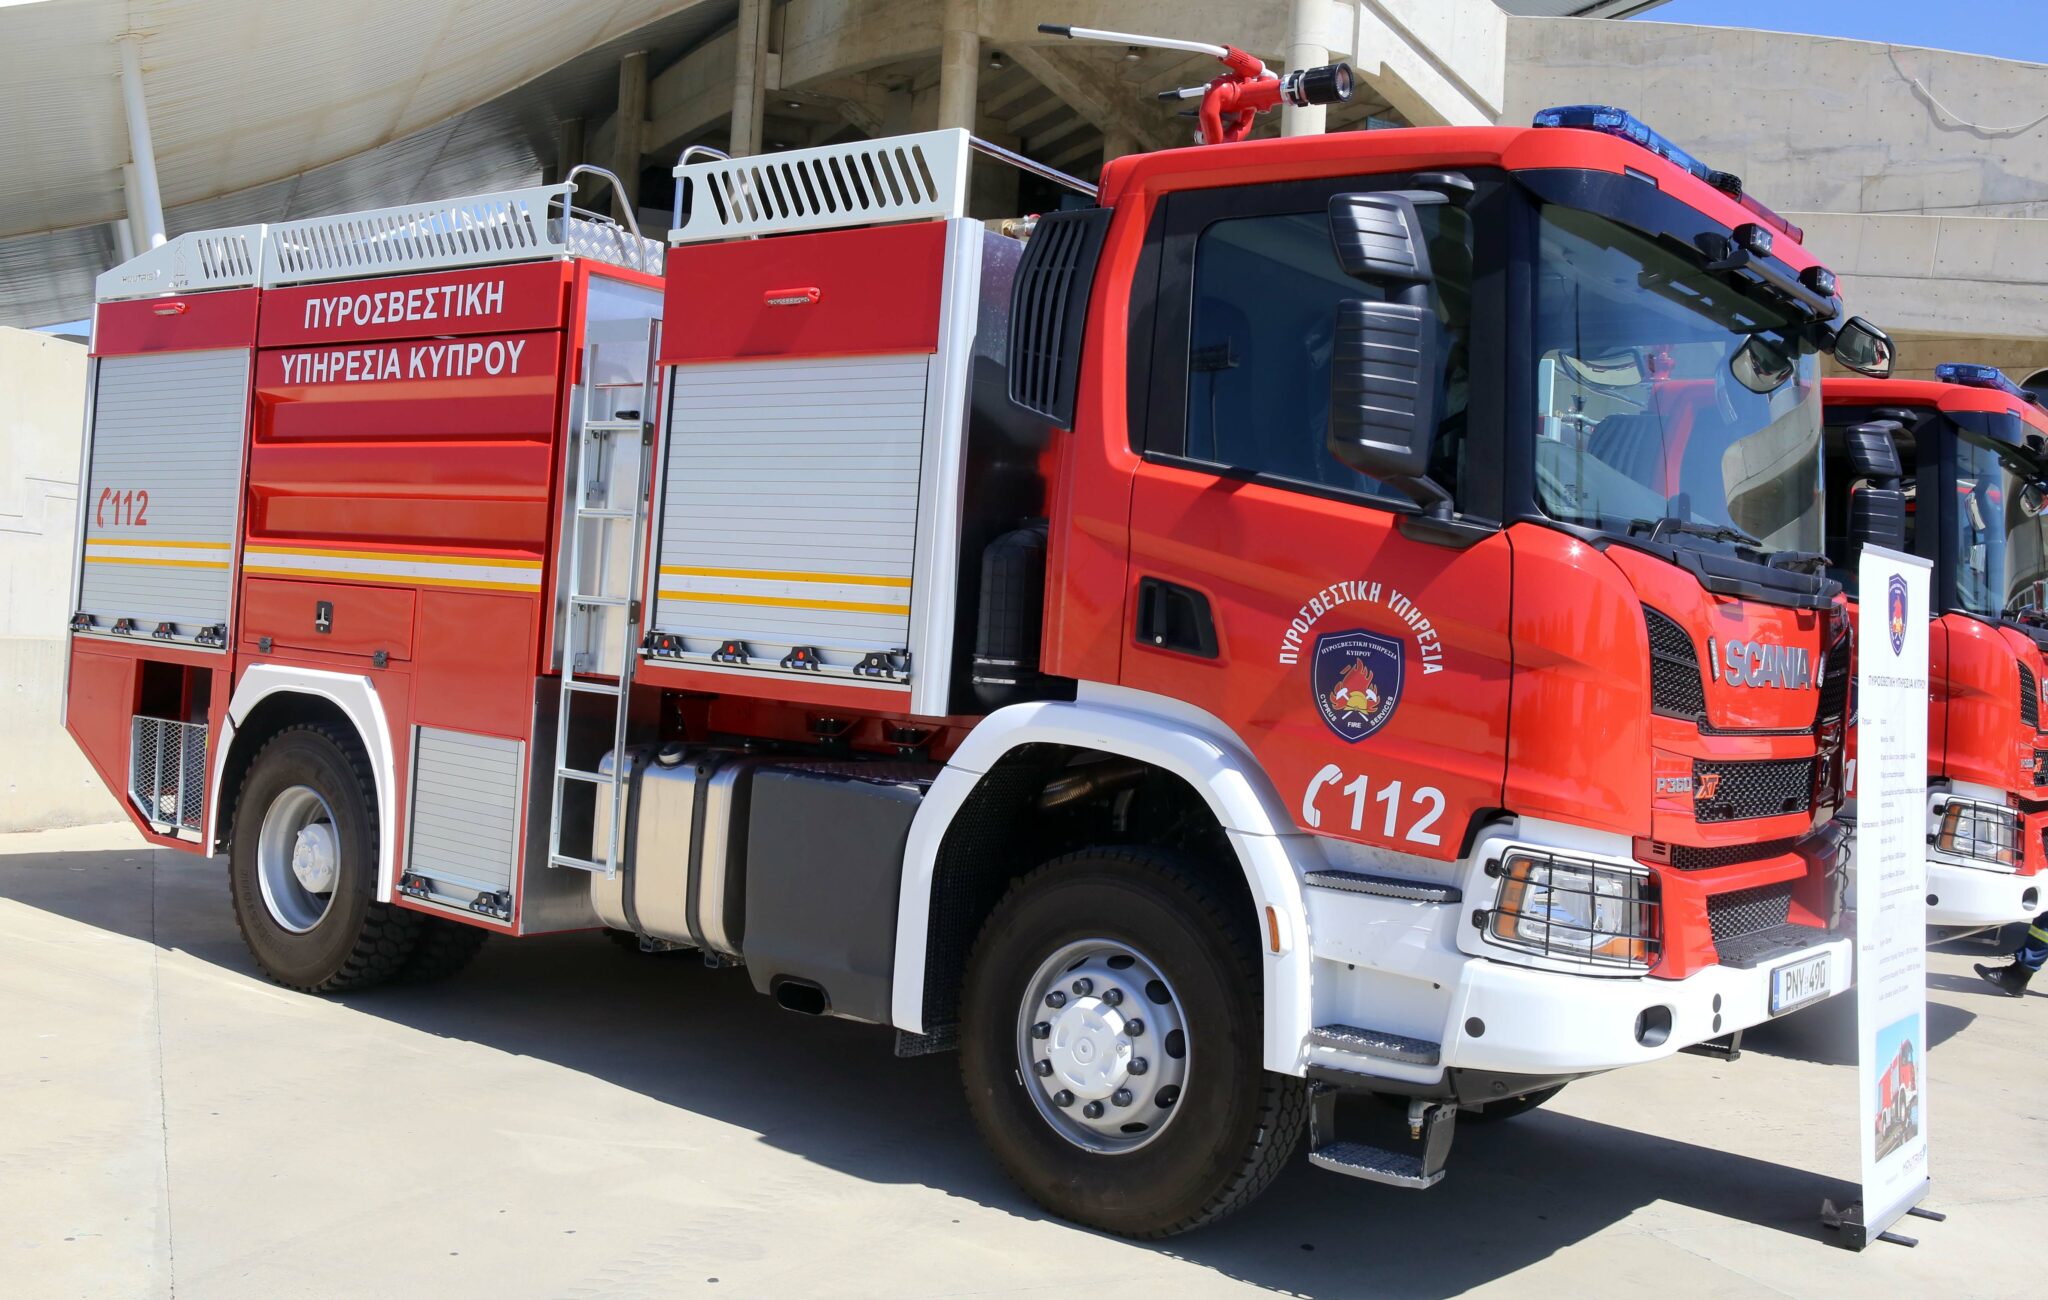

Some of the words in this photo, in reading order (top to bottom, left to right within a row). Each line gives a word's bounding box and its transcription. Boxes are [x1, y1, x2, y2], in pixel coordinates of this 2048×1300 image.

[304, 280, 505, 329] ΠΥΡΟΣΒΕΣΤΙΚΗ
[281, 348, 401, 384] ΥΠΗΡΕΣΙΑ
[408, 339, 526, 379] ΚΥΠΡΟΥ
[112, 490, 149, 526] 112
[1279, 580, 1382, 665] ΠΥΡΟΣΒΕΣΤΙΚΗ
[1387, 589, 1443, 675] ΥΠΗΡΕΣΙΑ
[1321, 641, 1368, 655] ΠΥΡΟΣΒΕΣΤΙΚΗ
[1368, 643, 1397, 660] ΥΠΗΡΕΣΙΑ
[1725, 639, 1811, 690] SCANIA
[1320, 693, 1337, 722] CYPRUS
[1347, 721, 1362, 729] FIRE
[1370, 696, 1394, 726] SERVICES
[1697, 774, 1719, 799] XT
[1343, 774, 1446, 846] 112
[1785, 967, 1805, 1001] PNY
[1809, 960, 1826, 992] 490
